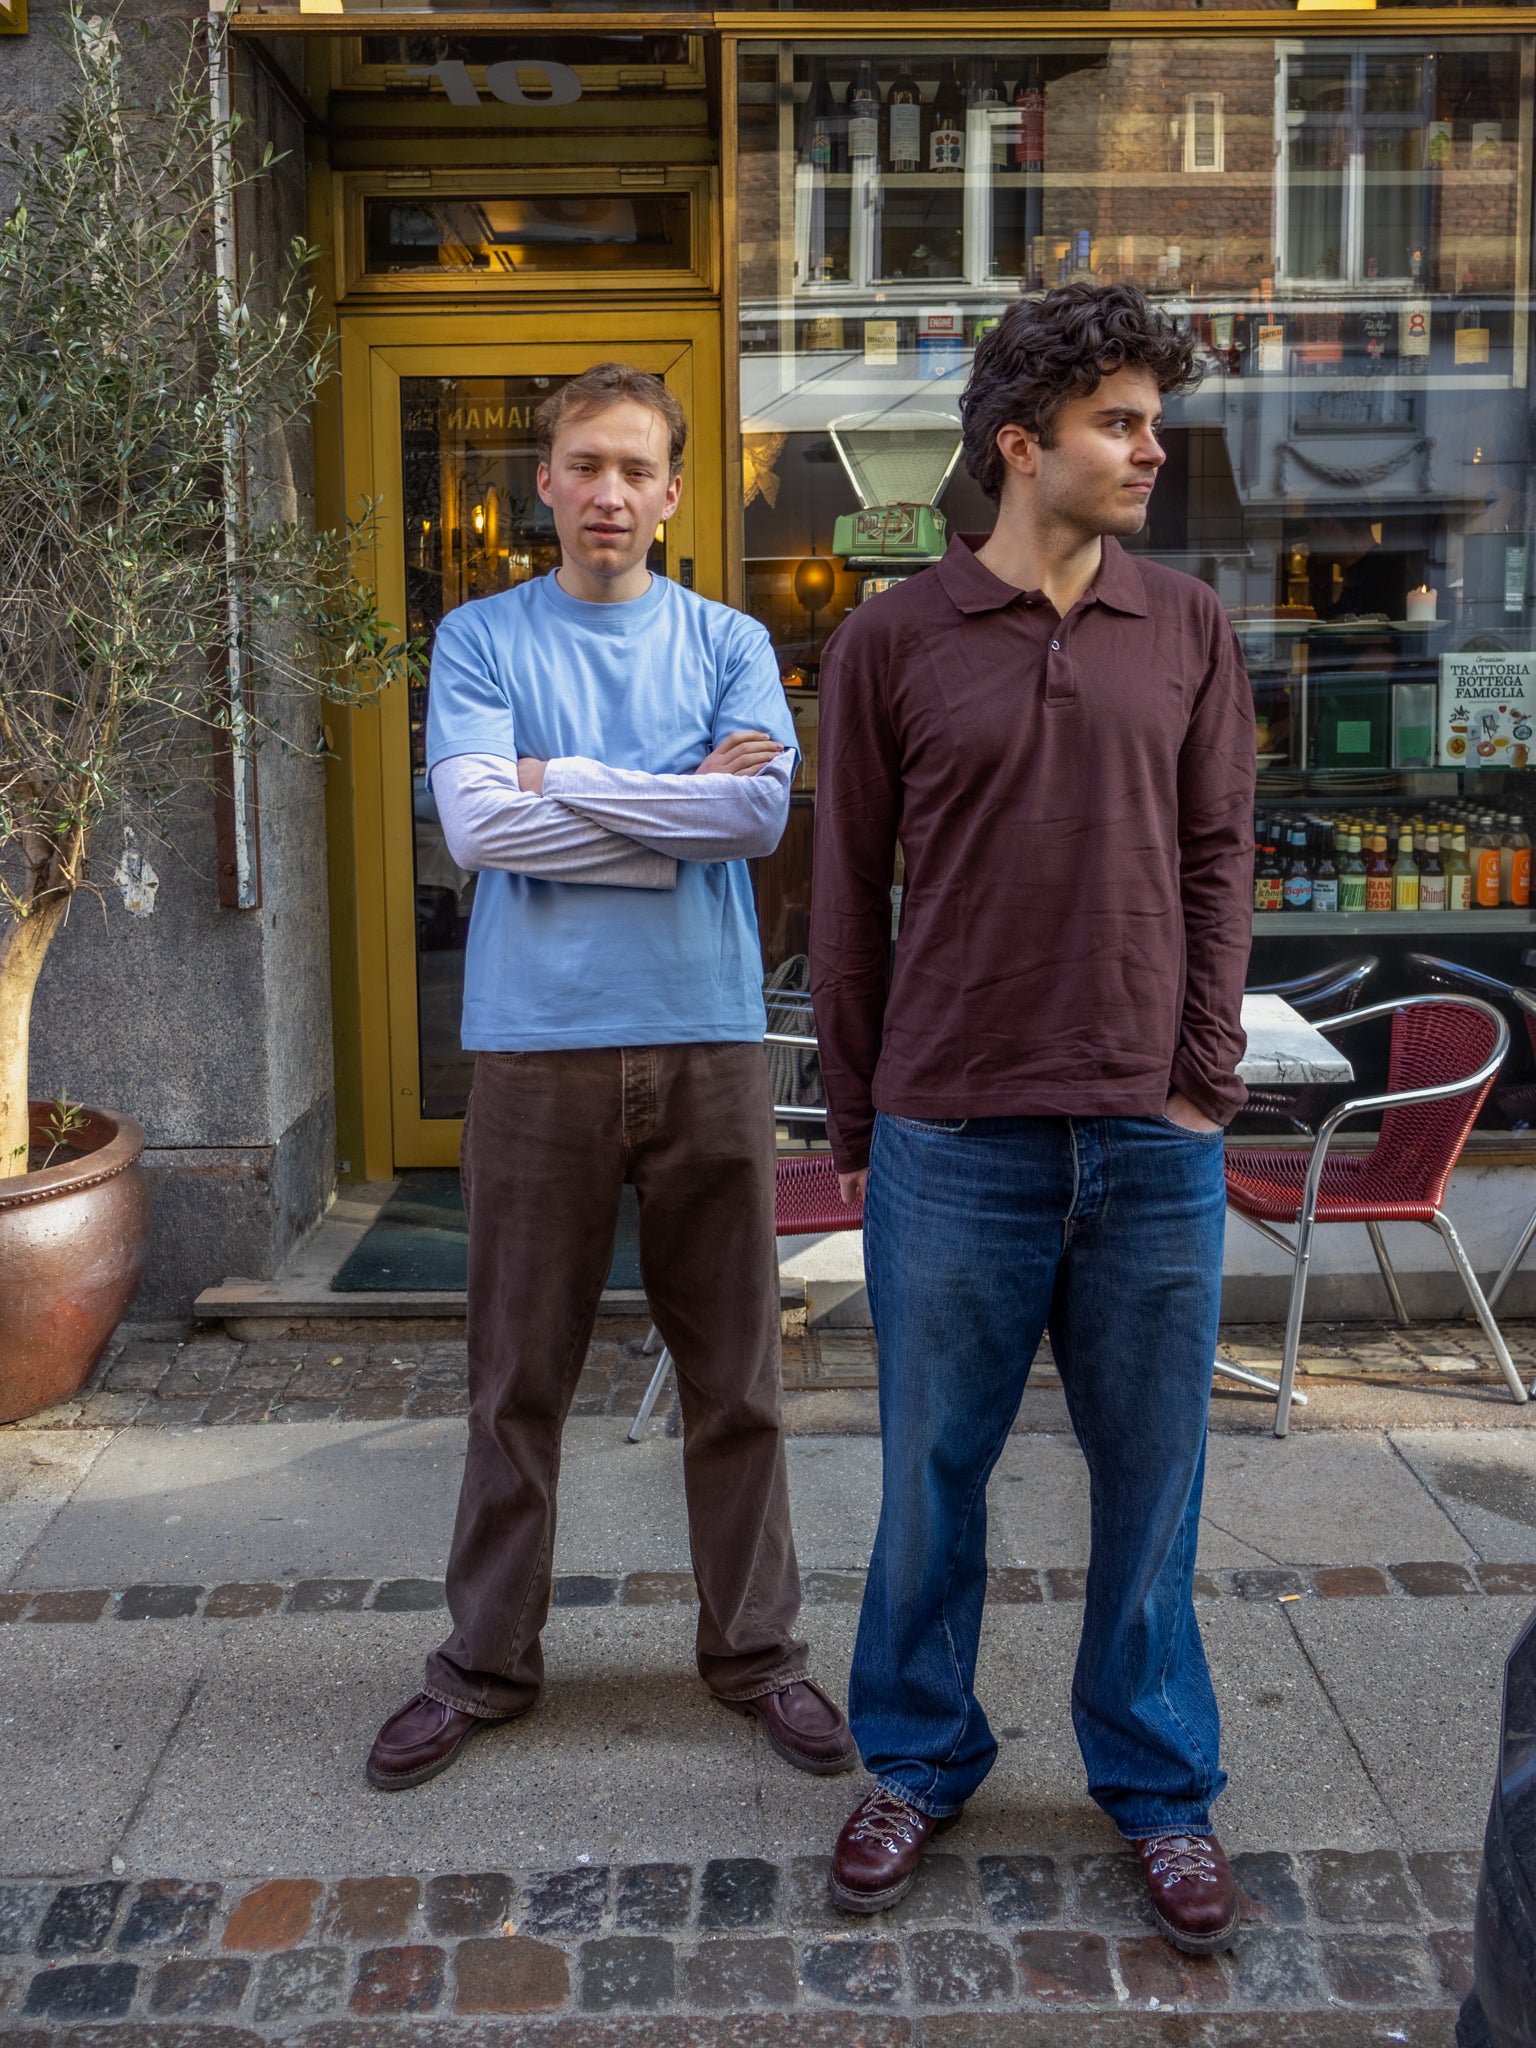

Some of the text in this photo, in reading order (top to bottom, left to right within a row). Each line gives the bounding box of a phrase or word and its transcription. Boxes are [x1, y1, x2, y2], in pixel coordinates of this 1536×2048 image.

[405, 60, 582, 106] 10
[929, 318, 952, 328] ENGINE
[1410, 313, 1425, 337] 8
[1450, 664, 1530, 676] TRATTORIA
[1457, 676, 1523, 687] BOTTEGA
[1455, 687, 1525, 698] FAMIGLIA
[1368, 881, 1391, 890] RAN
[1368, 900, 1391, 909] OSSA
